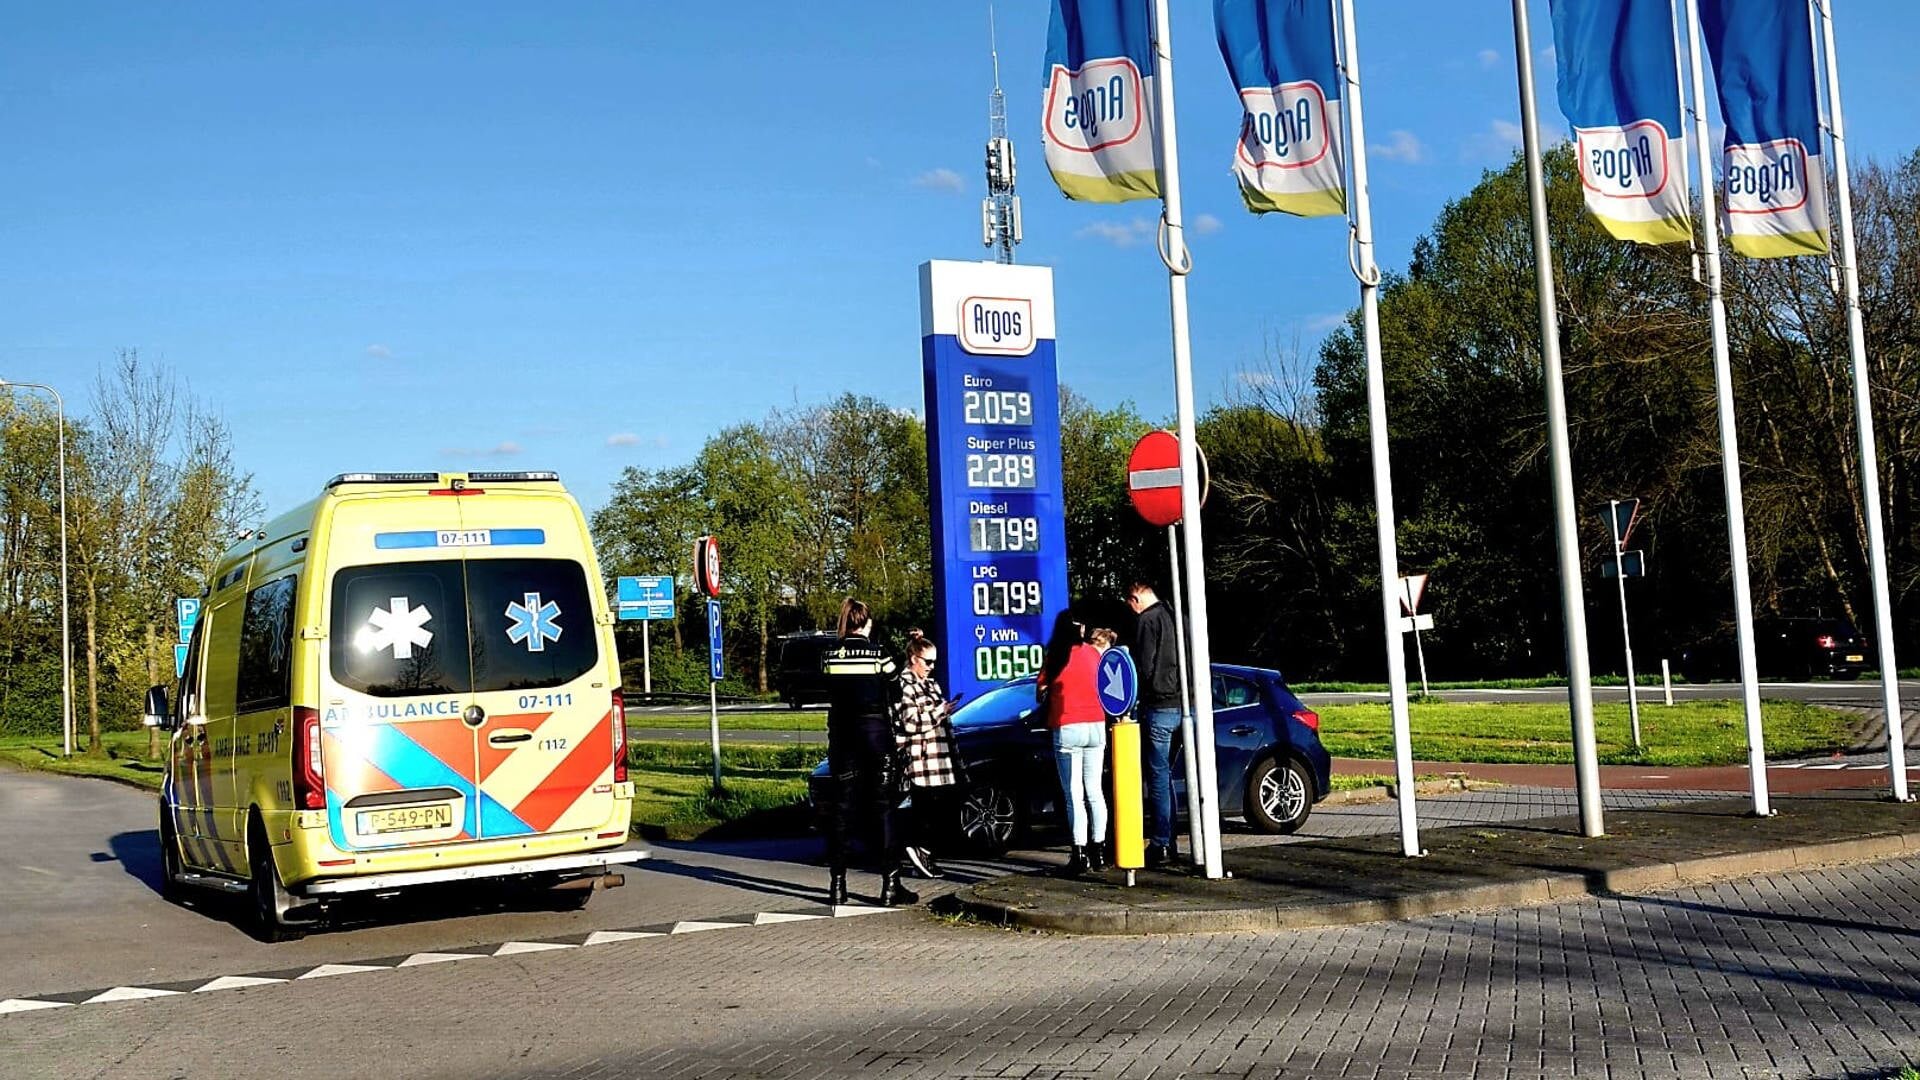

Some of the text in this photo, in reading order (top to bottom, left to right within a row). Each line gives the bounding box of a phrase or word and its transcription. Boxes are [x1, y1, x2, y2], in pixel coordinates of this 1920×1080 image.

[974, 303, 1022, 342] Argos
[963, 374, 993, 387] Euro
[964, 391, 1031, 424] 2.059
[967, 436, 1036, 452] Super Plus
[967, 454, 1034, 487] 2.289
[970, 501, 1008, 514] Diesel
[441, 532, 486, 544] 07-111
[977, 517, 1037, 550] 1.799
[972, 566, 998, 578] LPG
[973, 581, 1041, 615] 0.799
[181, 601, 197, 621] P
[712, 605, 720, 639] P
[991, 628, 1019, 641] kWh
[976, 645, 1043, 680] 0.650
[325, 700, 460, 721] AULANCE
[518, 693, 572, 709] 07-111
[545, 739, 567, 750] 112
